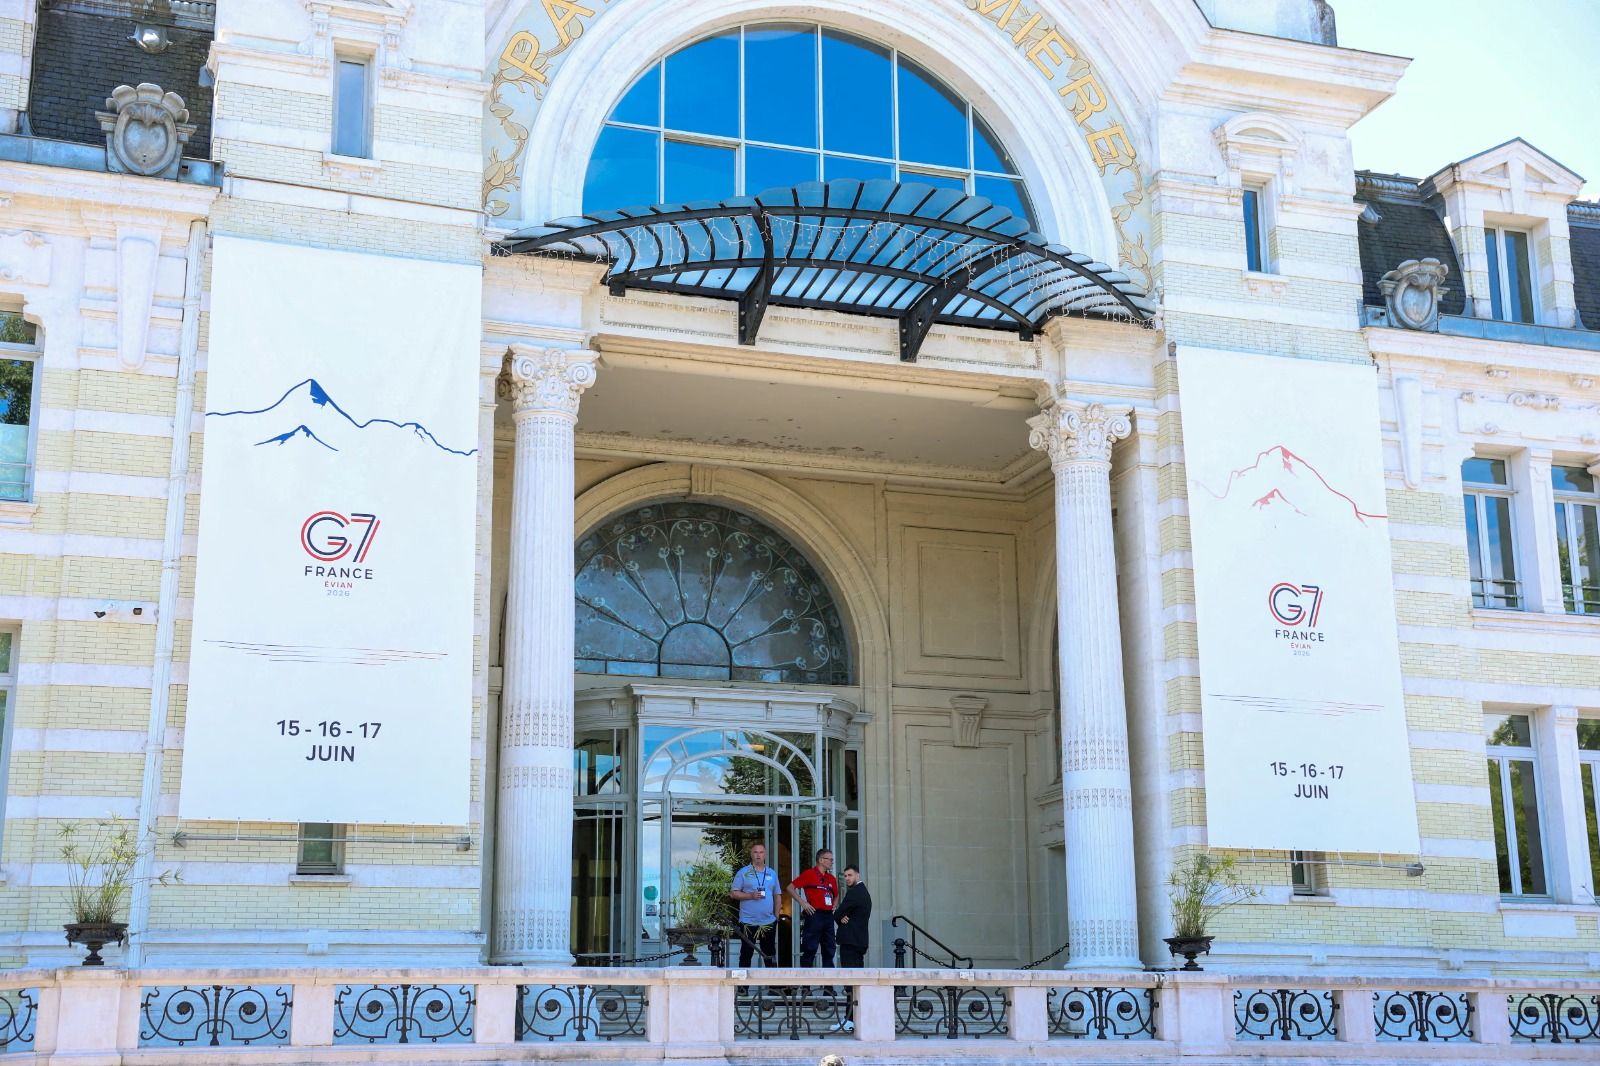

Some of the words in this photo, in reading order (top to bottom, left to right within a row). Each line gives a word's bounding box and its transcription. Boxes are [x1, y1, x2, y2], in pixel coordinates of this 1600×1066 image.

[501, 0, 608, 84] PA
[300, 510, 381, 563] G7
[304, 565, 373, 580] FRANCE
[324, 580, 353, 589] ÉVIAN
[1268, 582, 1324, 628] G7
[1275, 629, 1325, 642] FRANCE
[305, 744, 355, 762] JUIN
[1294, 783, 1329, 800] JUIN
